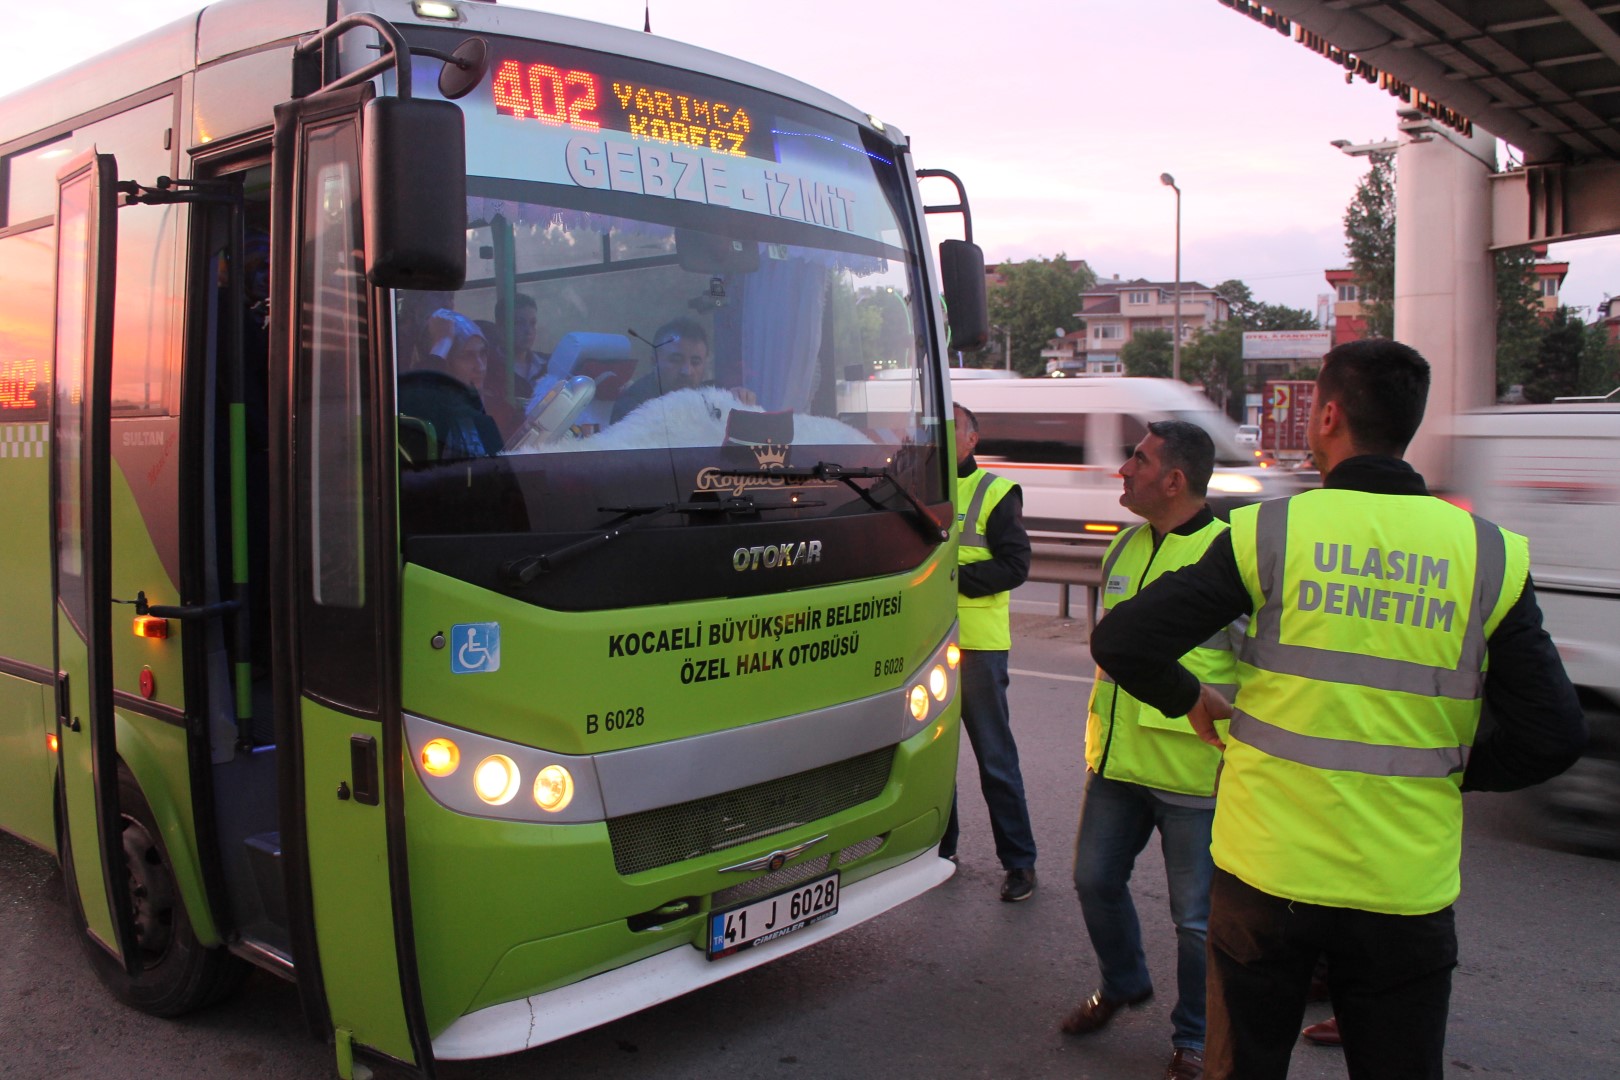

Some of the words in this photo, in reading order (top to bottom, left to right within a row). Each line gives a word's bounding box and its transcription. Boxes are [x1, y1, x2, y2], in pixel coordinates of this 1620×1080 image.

[493, 60, 600, 132] 402
[612, 82, 751, 134] YARIMCA
[565, 136, 728, 205] GEBZE
[122, 431, 164, 446] SULTAN
[732, 540, 822, 572] OTOKAR
[608, 620, 702, 658] KOCAELİ
[708, 605, 821, 642] BÜYÜKŞEHİR
[826, 590, 902, 628] BELEDİYESİ
[1298, 588, 1456, 633] DENETİM
[680, 657, 730, 684] ÖZEL
[736, 648, 784, 678] HALK
[788, 630, 860, 666] OTOBÜSÜ
[874, 662, 881, 677] B
[883, 656, 904, 675] 6028
[586, 714, 599, 734] B
[605, 706, 645, 731] 6028
[713, 935, 723, 946] TR
[725, 910, 747, 943] 41
[765, 901, 776, 930] J
[790, 879, 835, 920] 6028
